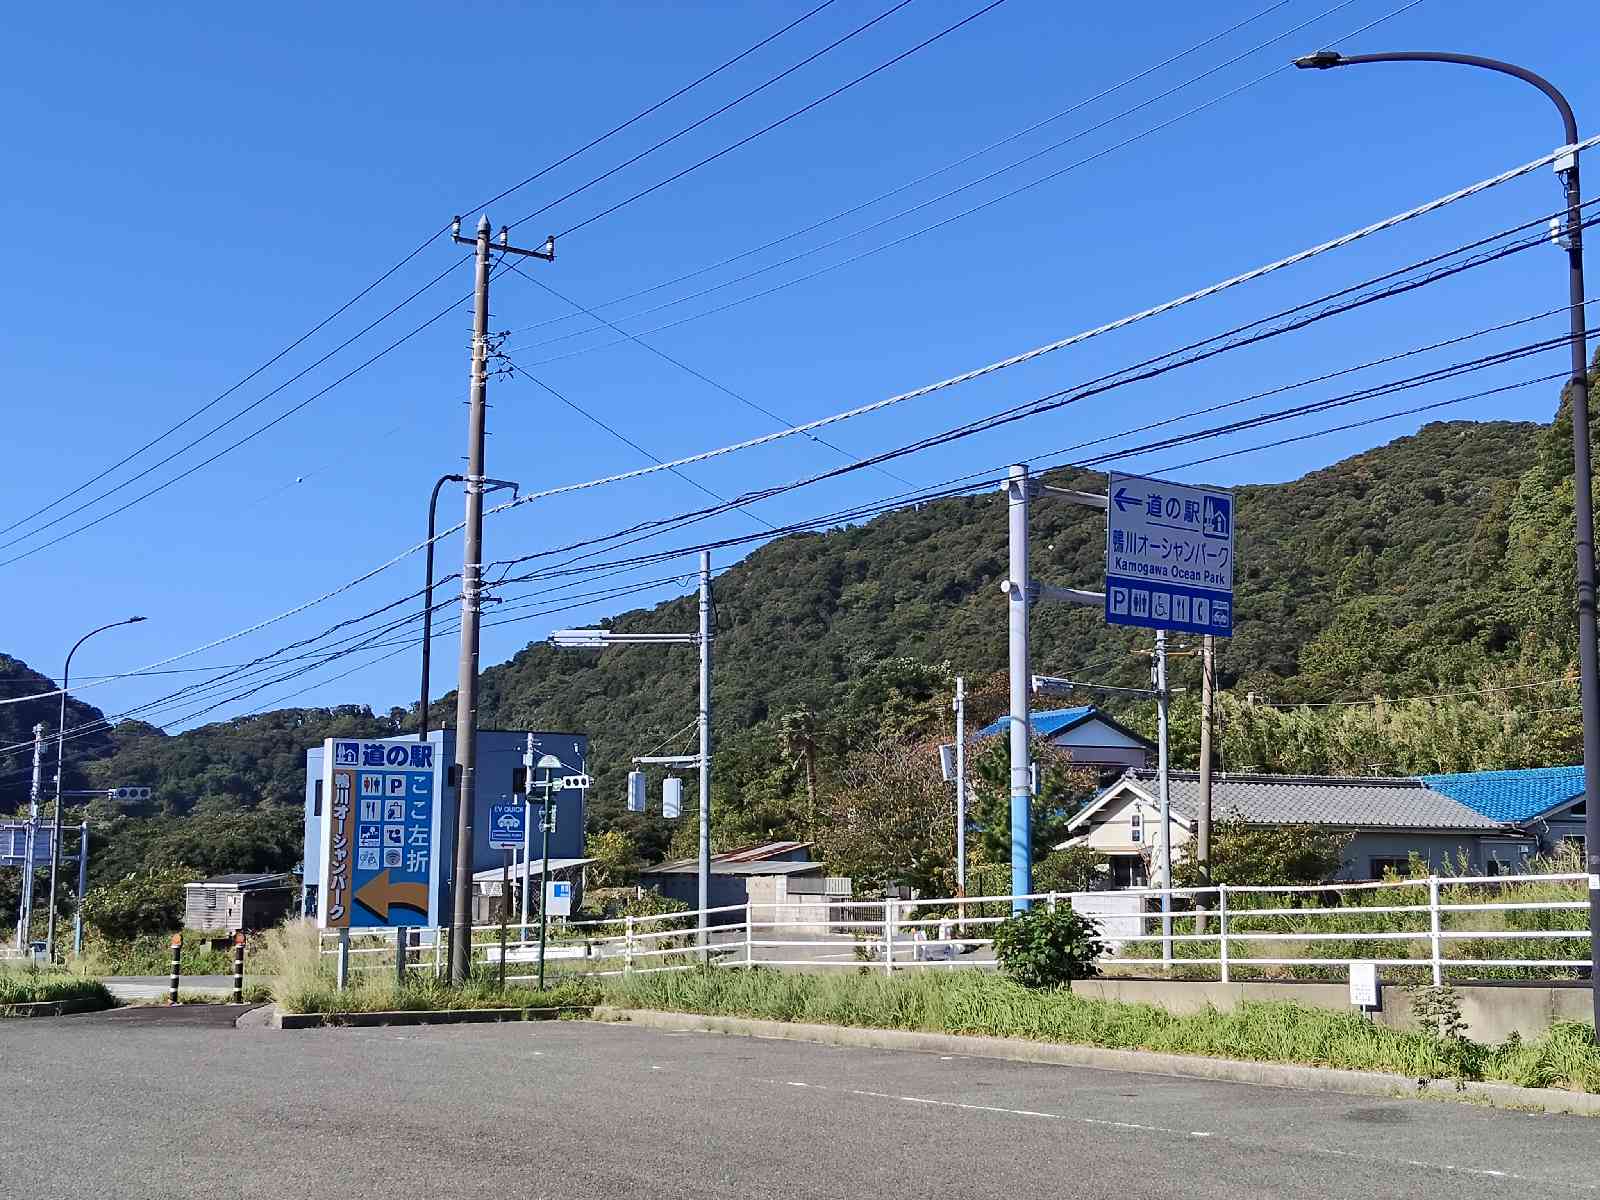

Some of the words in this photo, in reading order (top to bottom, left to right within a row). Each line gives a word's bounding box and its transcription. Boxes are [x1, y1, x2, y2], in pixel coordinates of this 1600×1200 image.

[1145, 493, 1200, 524] 道の駅
[1115, 556, 1168, 577] Kamogawa
[1171, 565, 1201, 582] Ocean
[1204, 570, 1225, 585] Park
[362, 743, 433, 768] 道の駅
[406, 776, 428, 873] ここ左折
